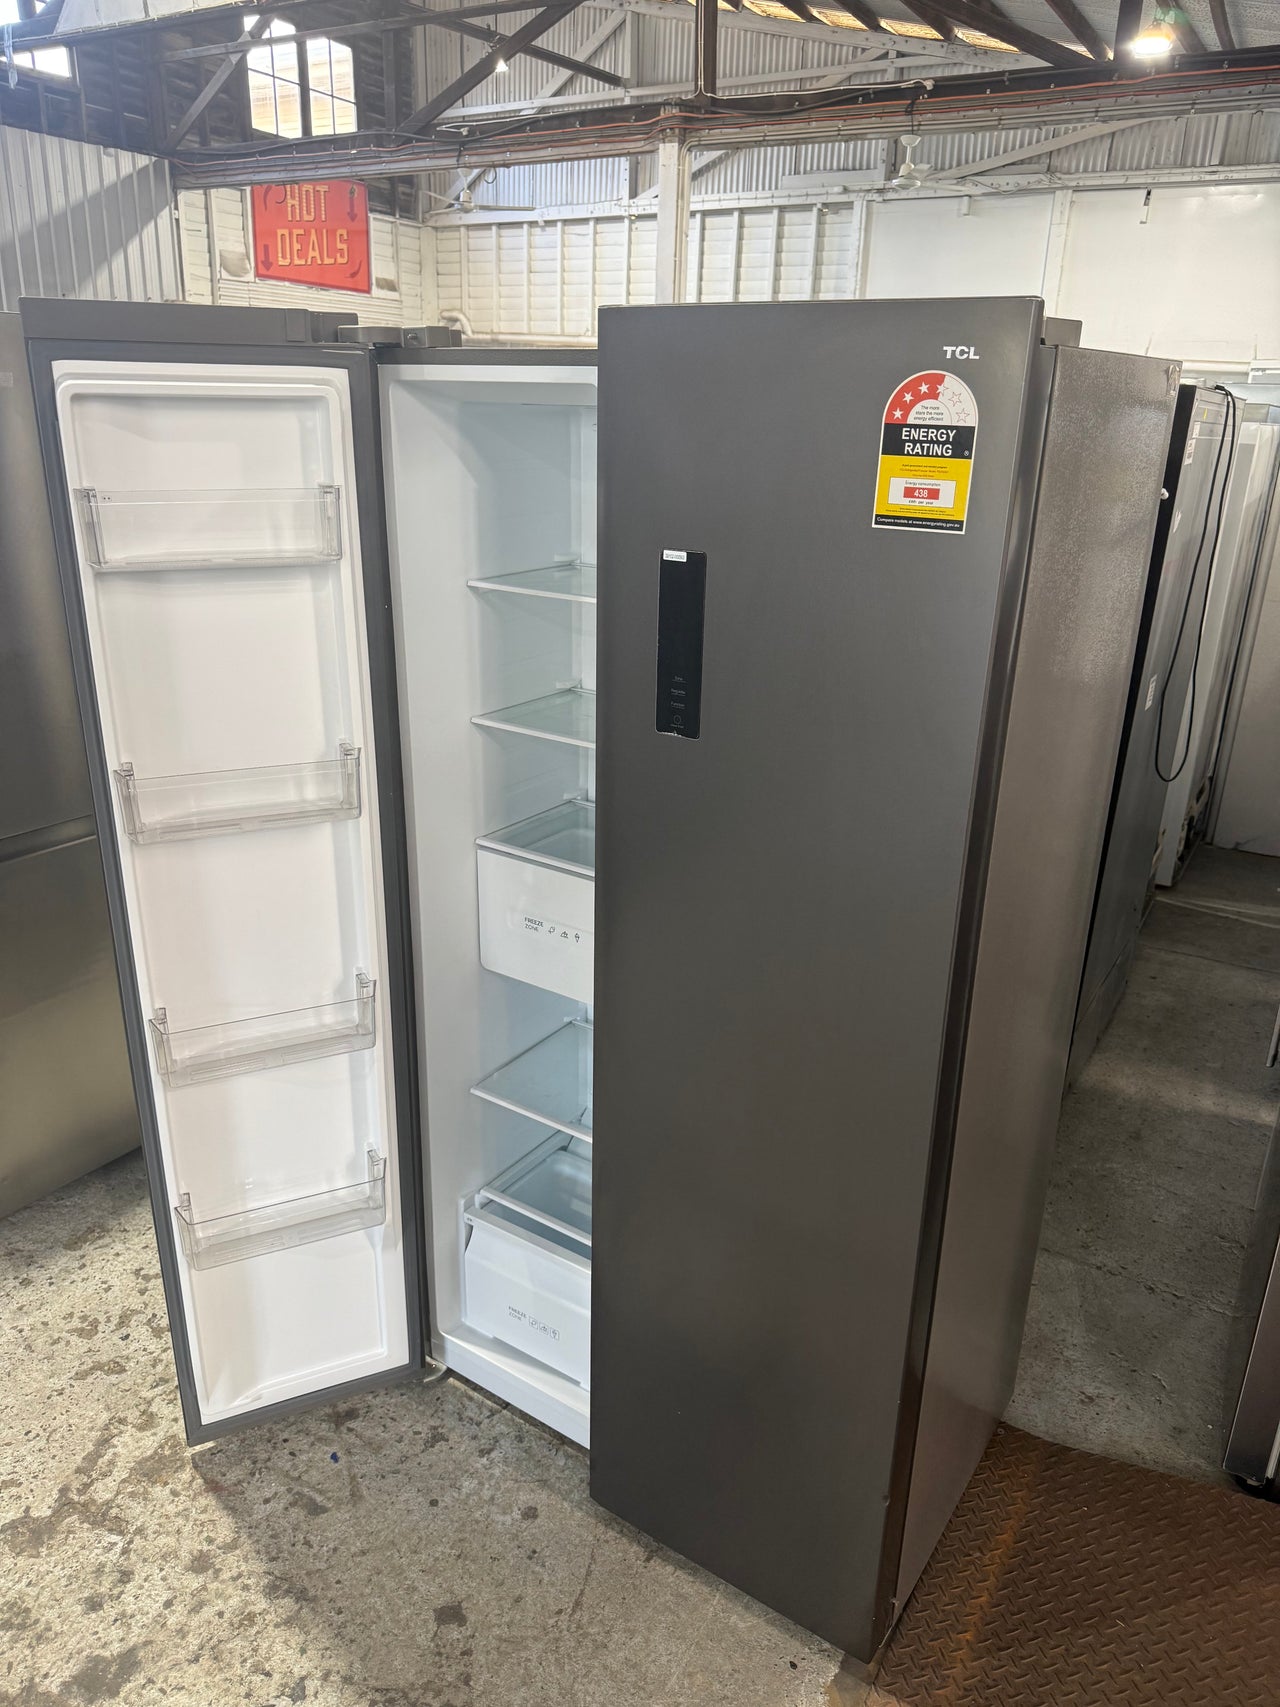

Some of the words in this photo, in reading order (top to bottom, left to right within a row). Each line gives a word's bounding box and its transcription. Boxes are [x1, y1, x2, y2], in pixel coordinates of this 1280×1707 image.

[286, 184, 329, 222] HOT
[277, 228, 348, 266] DEALS
[943, 346, 980, 360] TCL
[901, 428, 956, 442] ENERGY
[904, 442, 952, 456] RATING
[914, 489, 928, 498] 438
